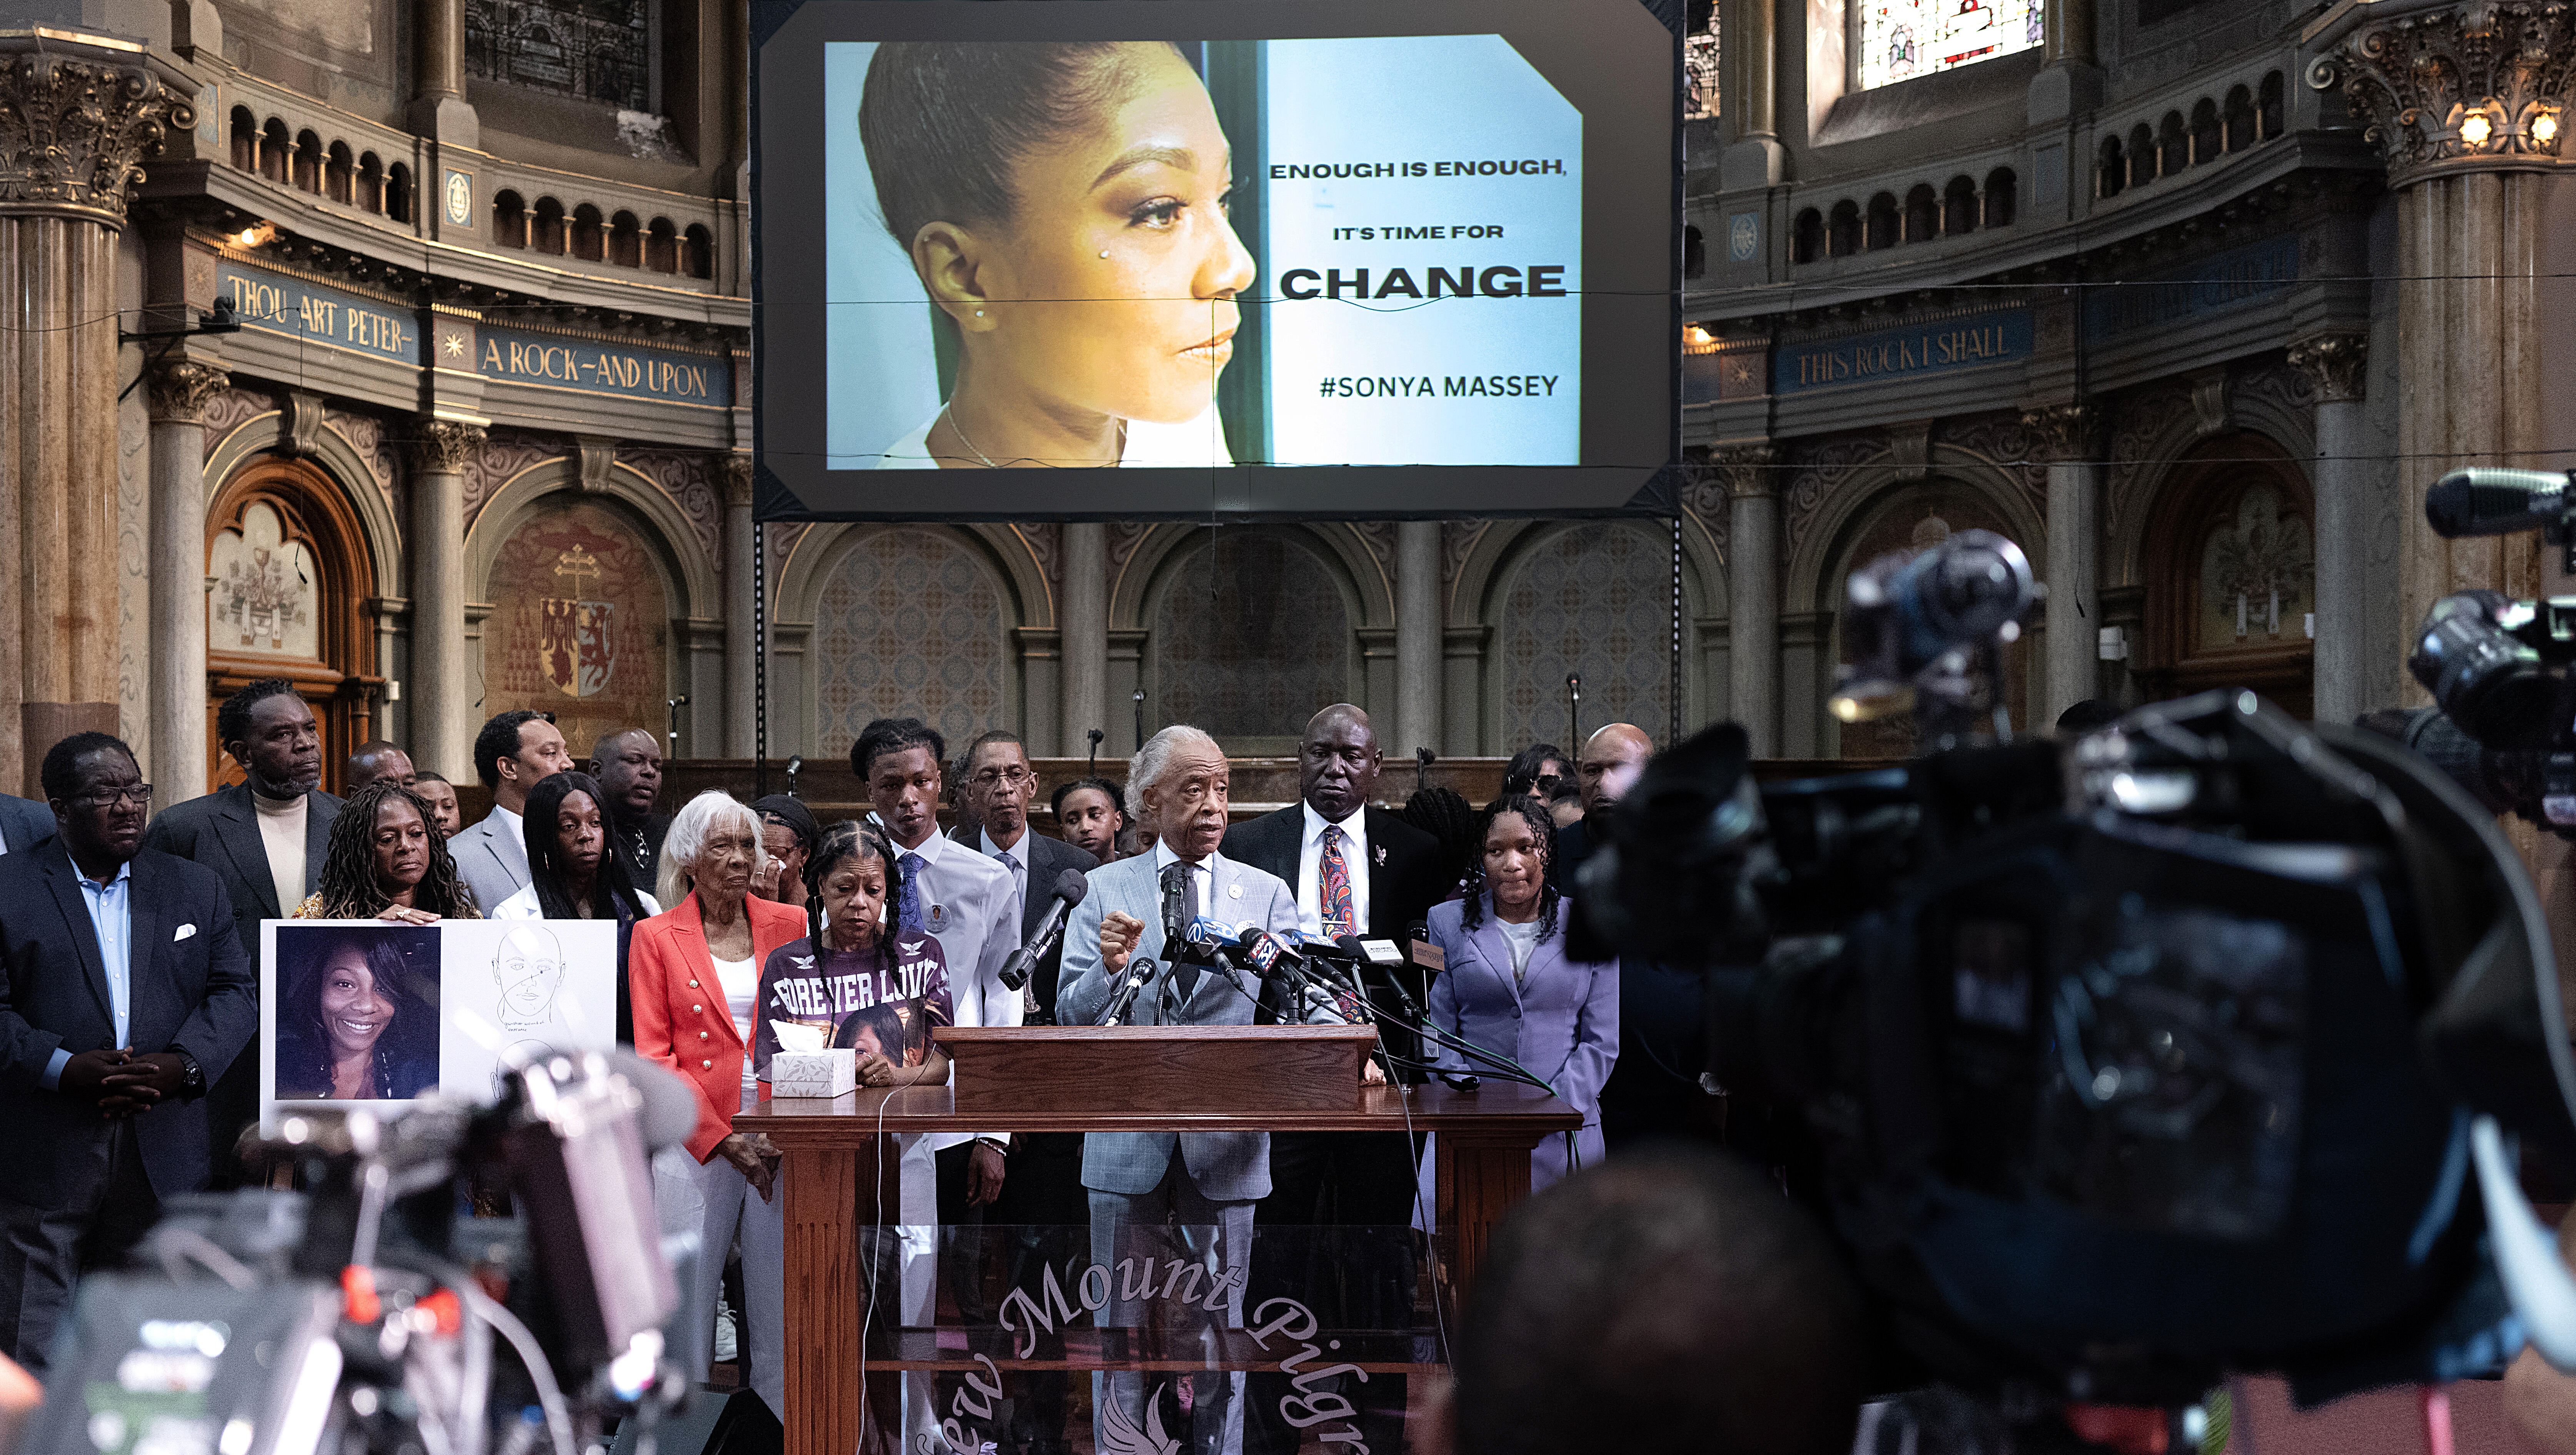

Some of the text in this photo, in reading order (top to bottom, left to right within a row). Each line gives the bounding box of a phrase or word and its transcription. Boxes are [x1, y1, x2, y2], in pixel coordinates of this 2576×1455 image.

[1270, 159, 1568, 179] ENOUGH IS ENOUGH,
[1333, 225, 1504, 240] IT'S TIME FOR
[1280, 265, 1567, 300] CHANGE
[228, 275, 287, 324] THOU
[297, 295, 338, 336] ART
[482, 339, 504, 372] A
[648, 359, 707, 397] UPON
[1797, 326, 2010, 384] THIS ROCK I SHALL
[1319, 375, 1559, 397] #SONYA MASSEY
[1252, 935, 1267, 956] FOX
[1257, 941, 1275, 966] 32
[773, 972, 875, 1015] FOREVER
[915, 1352, 1003, 1455] ew
[999, 1256, 1242, 1360] Mount
